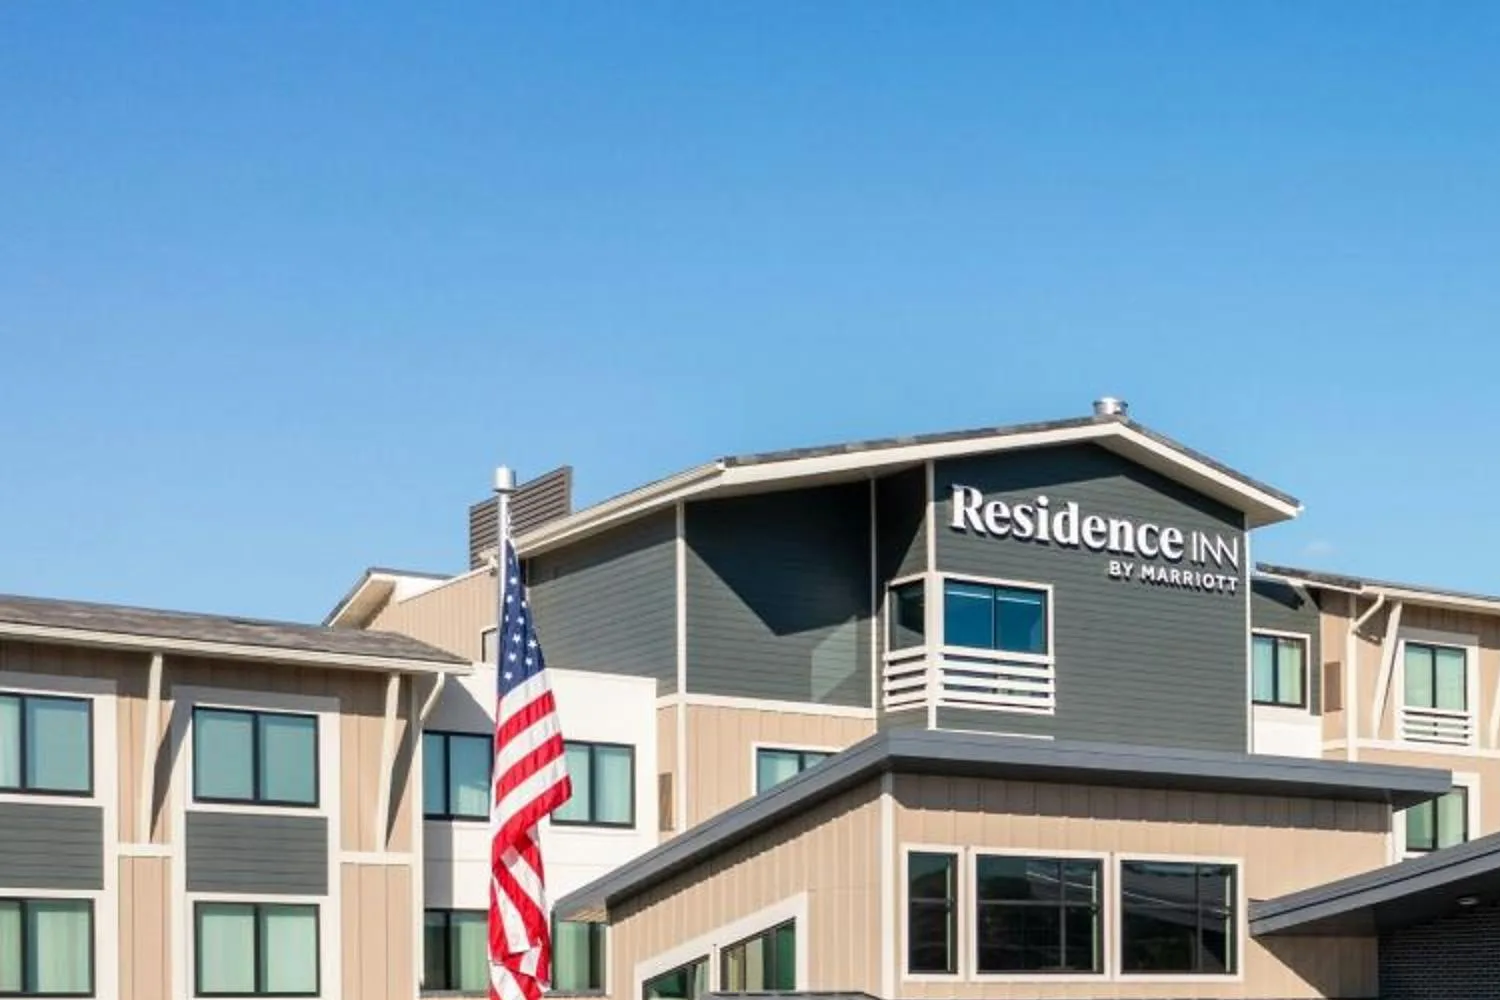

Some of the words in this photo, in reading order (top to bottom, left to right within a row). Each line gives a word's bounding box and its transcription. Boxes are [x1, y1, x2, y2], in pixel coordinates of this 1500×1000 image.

[950, 484, 1184, 560] Residence
[1191, 531, 1239, 568] INN
[1108, 560, 1133, 577] BY
[1141, 564, 1239, 591] MARRIOTT
